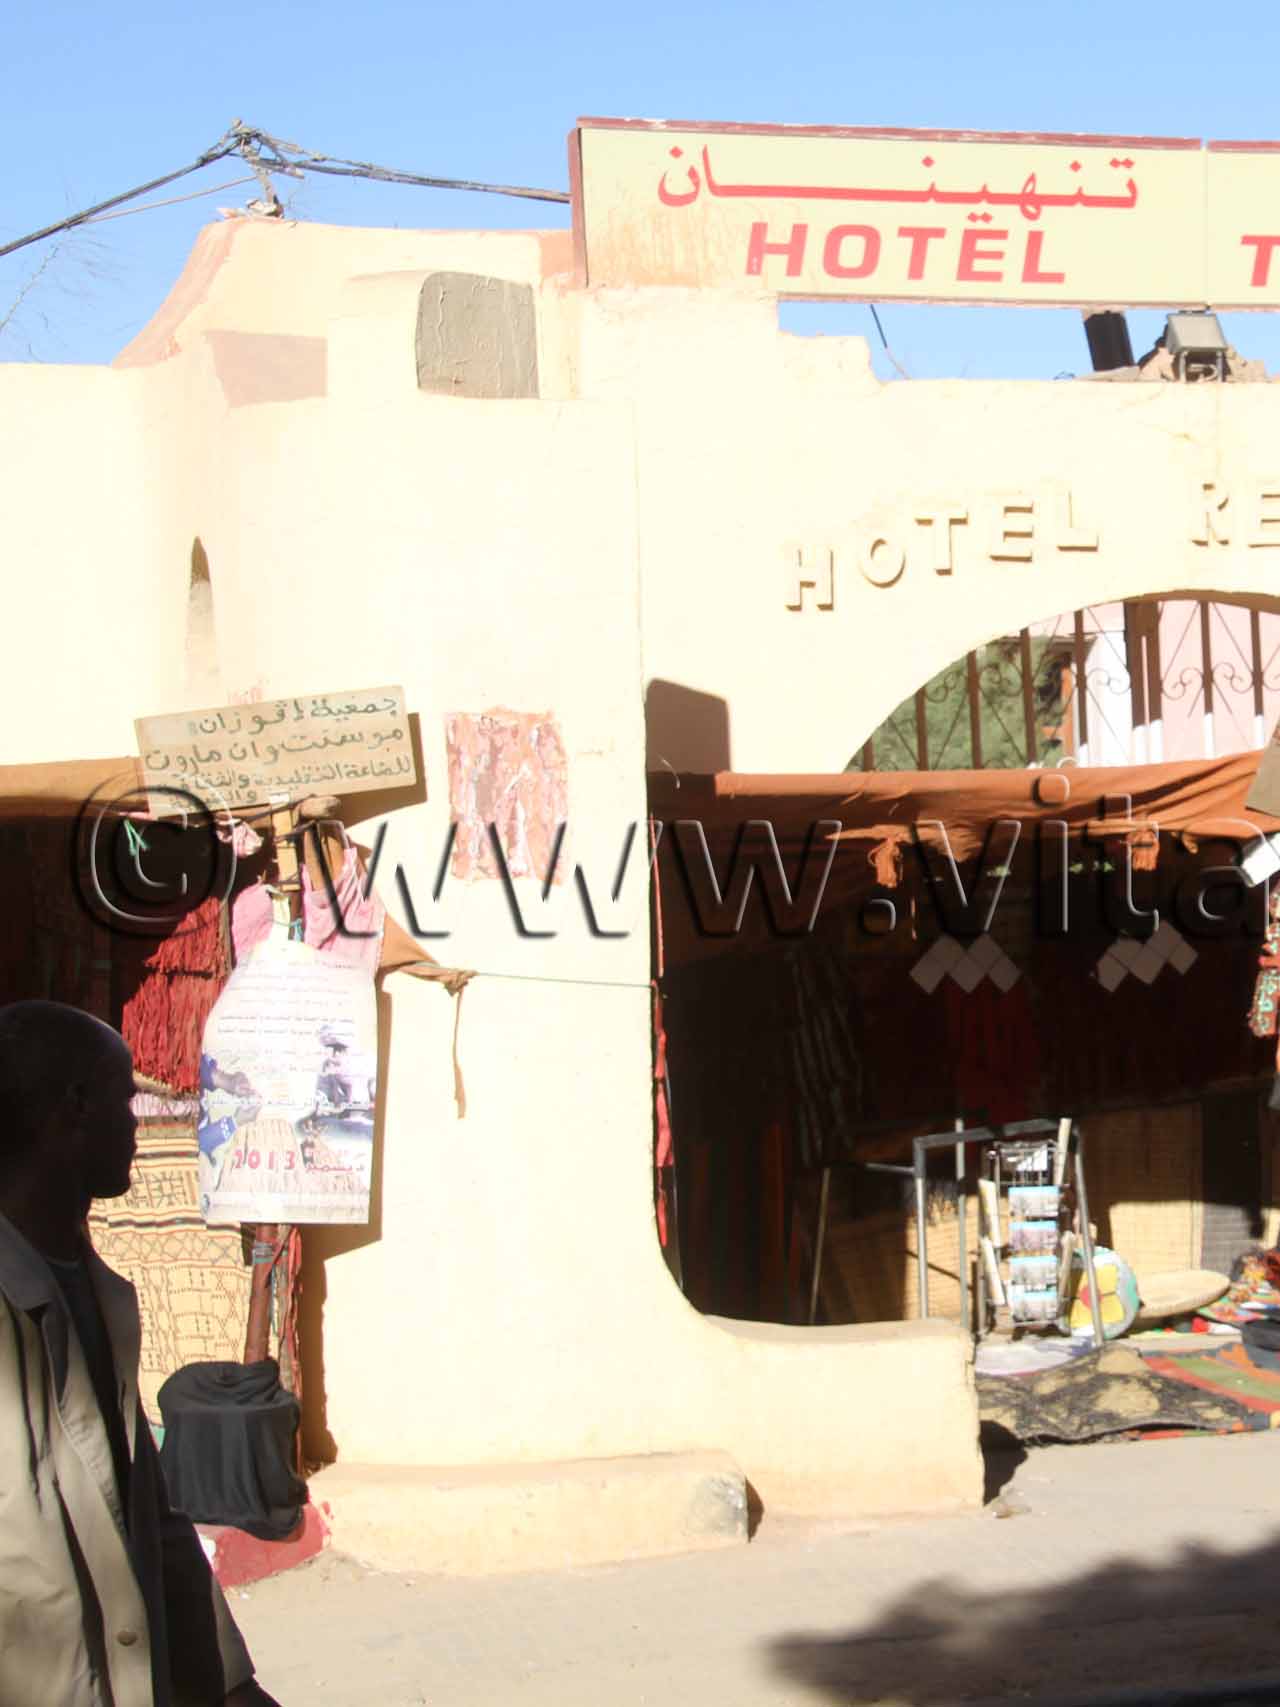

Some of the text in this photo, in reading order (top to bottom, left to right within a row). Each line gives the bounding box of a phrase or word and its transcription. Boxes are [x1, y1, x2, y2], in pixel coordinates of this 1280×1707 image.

[657, 144, 1138, 221] تنهينان
[745, 222, 1066, 284] HOTEL
[783, 482, 1099, 611] HOTEL
[310, 695, 398, 721] جمعية
[233, 1150, 296, 1169] 2013
